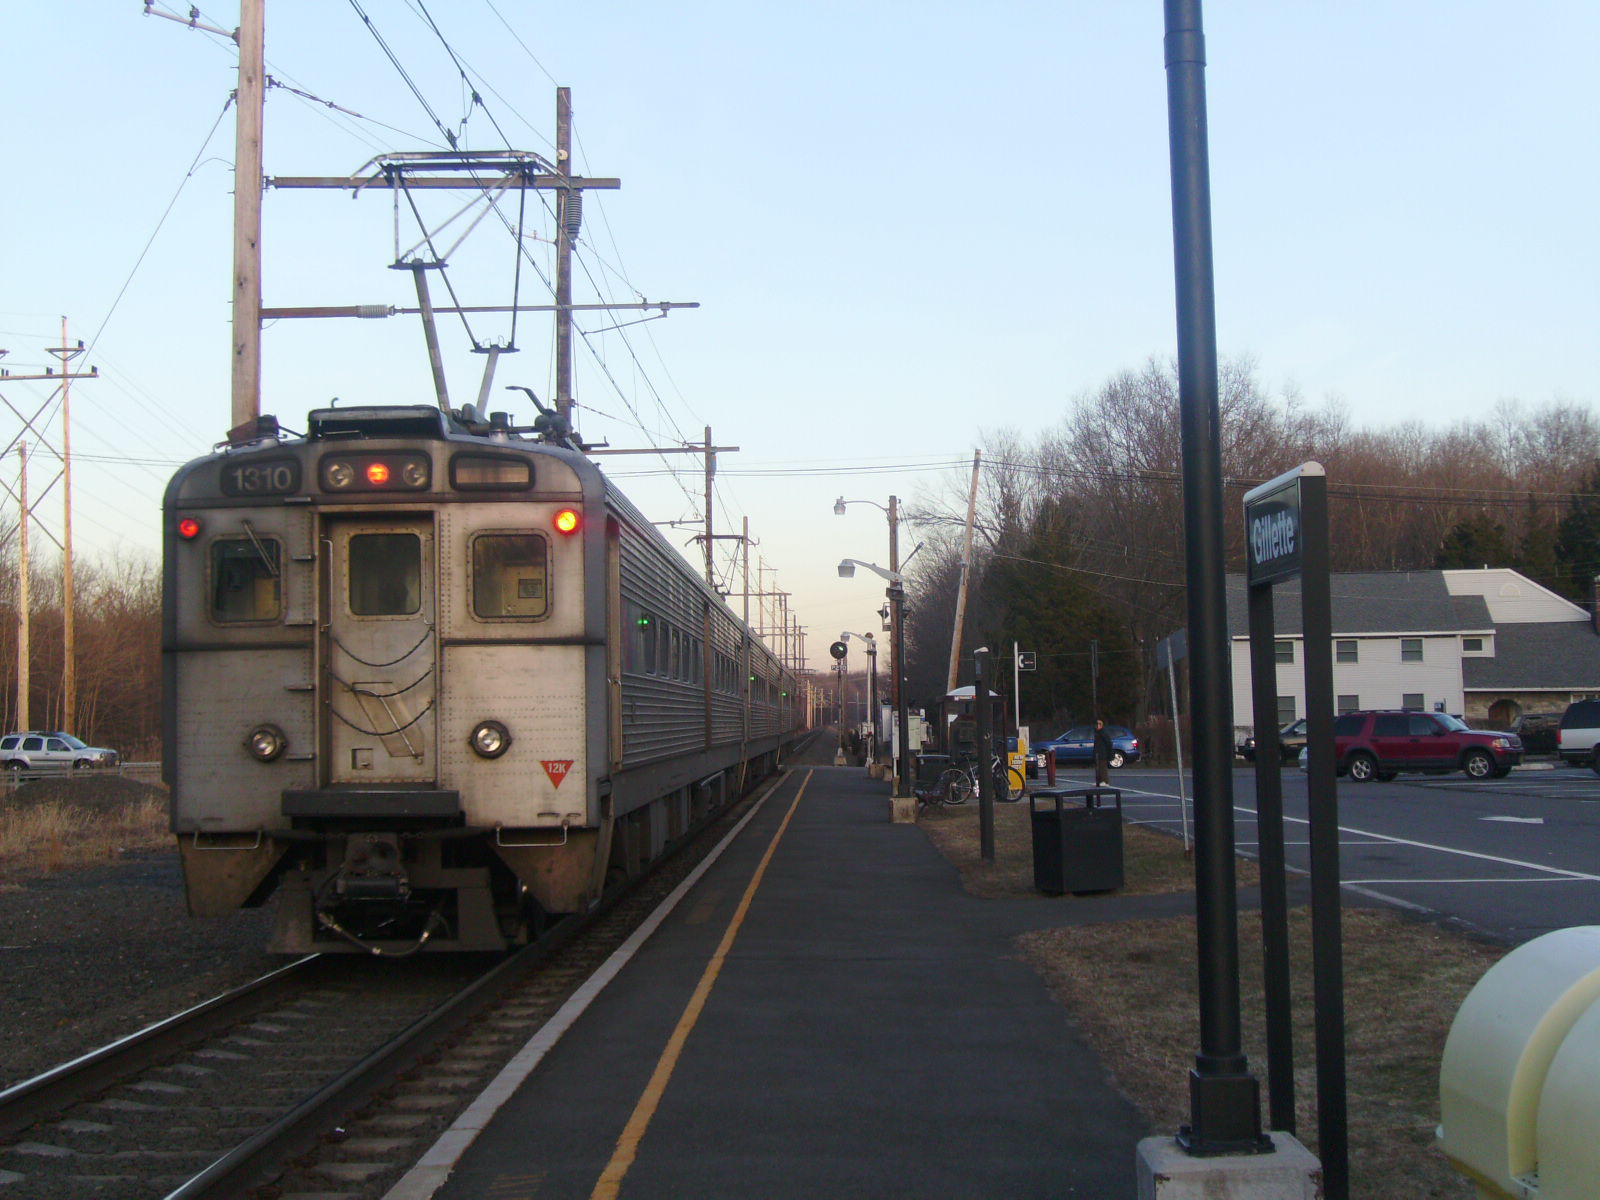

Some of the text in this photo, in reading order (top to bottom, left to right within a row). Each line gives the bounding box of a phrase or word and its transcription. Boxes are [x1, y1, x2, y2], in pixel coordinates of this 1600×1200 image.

[233, 467, 292, 491] 1310
[1253, 509, 1295, 564] Gillette
[548, 762, 566, 774] 12K
